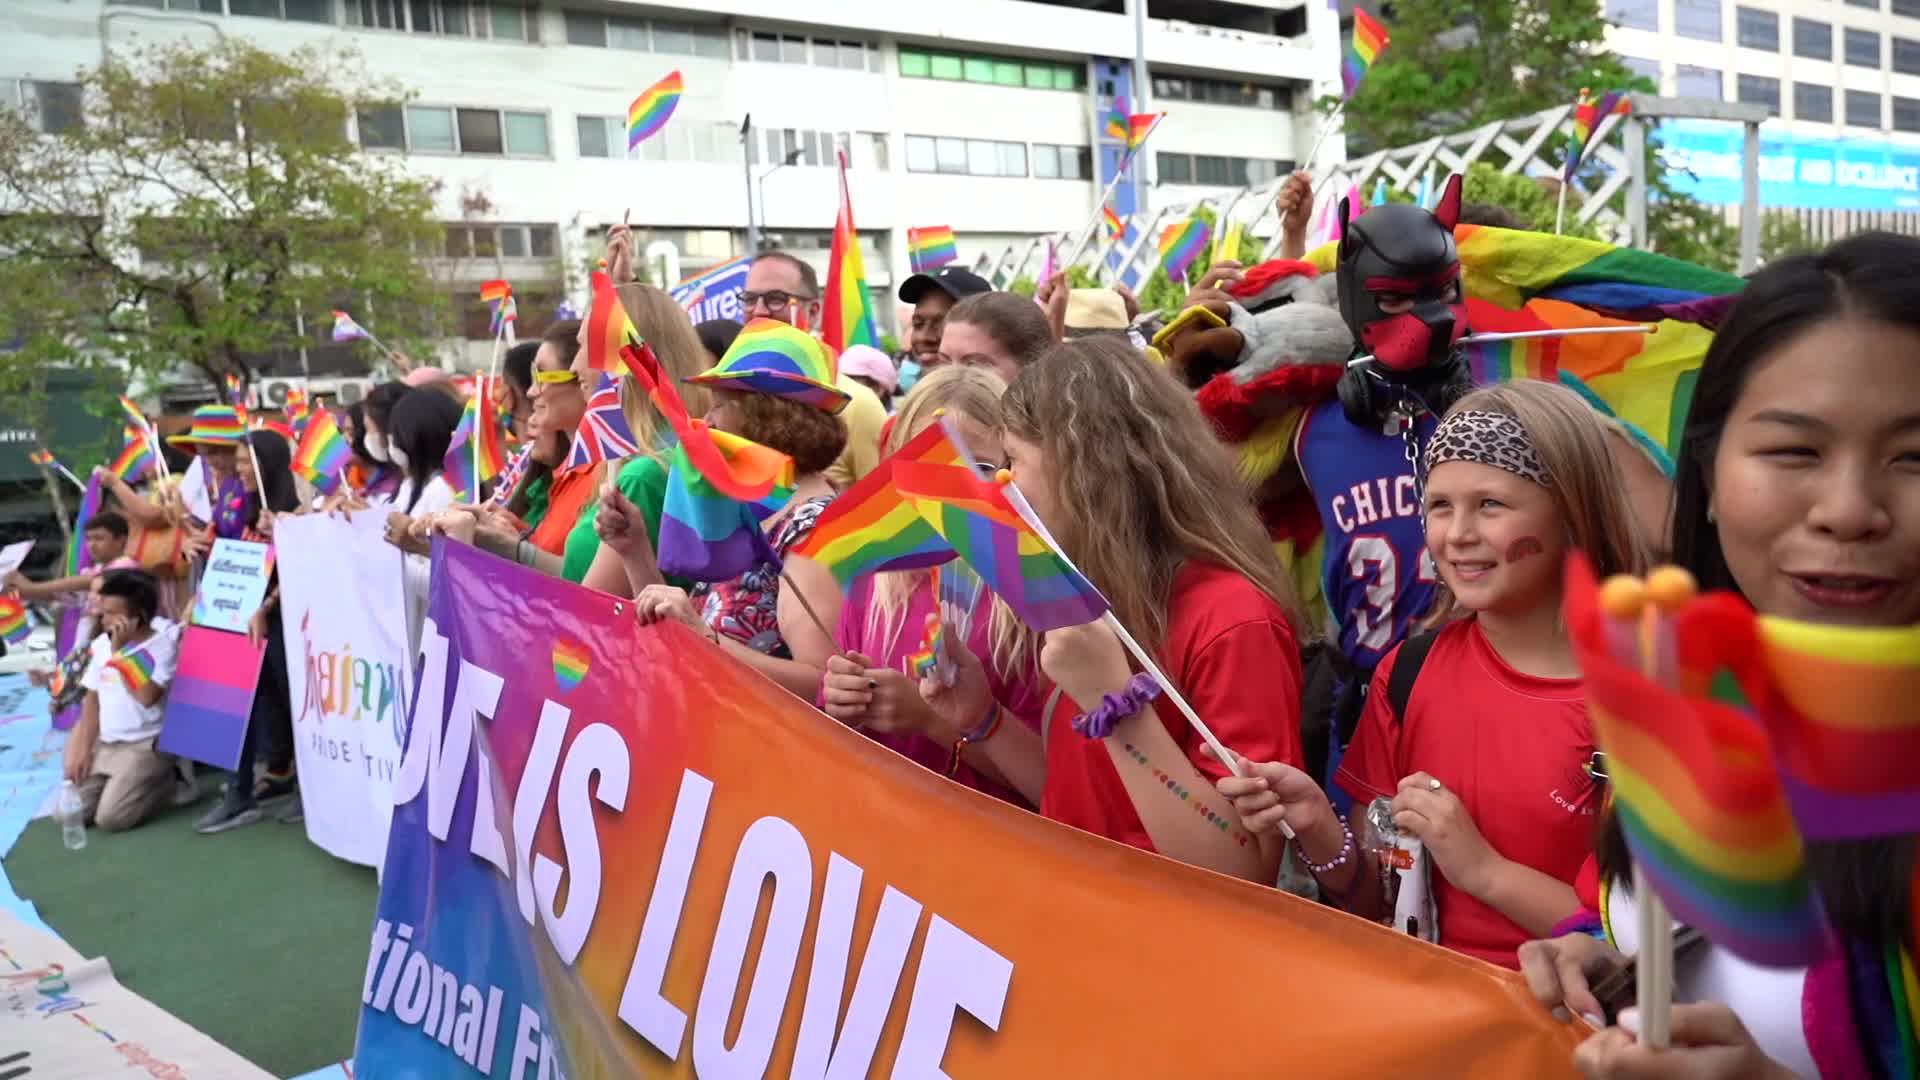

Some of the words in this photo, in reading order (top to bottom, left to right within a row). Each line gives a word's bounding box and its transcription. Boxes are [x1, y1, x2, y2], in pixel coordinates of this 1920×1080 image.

[1331, 474, 1422, 533] CHIC
[512, 697, 631, 968] IS
[617, 767, 1015, 1080] LOVE
